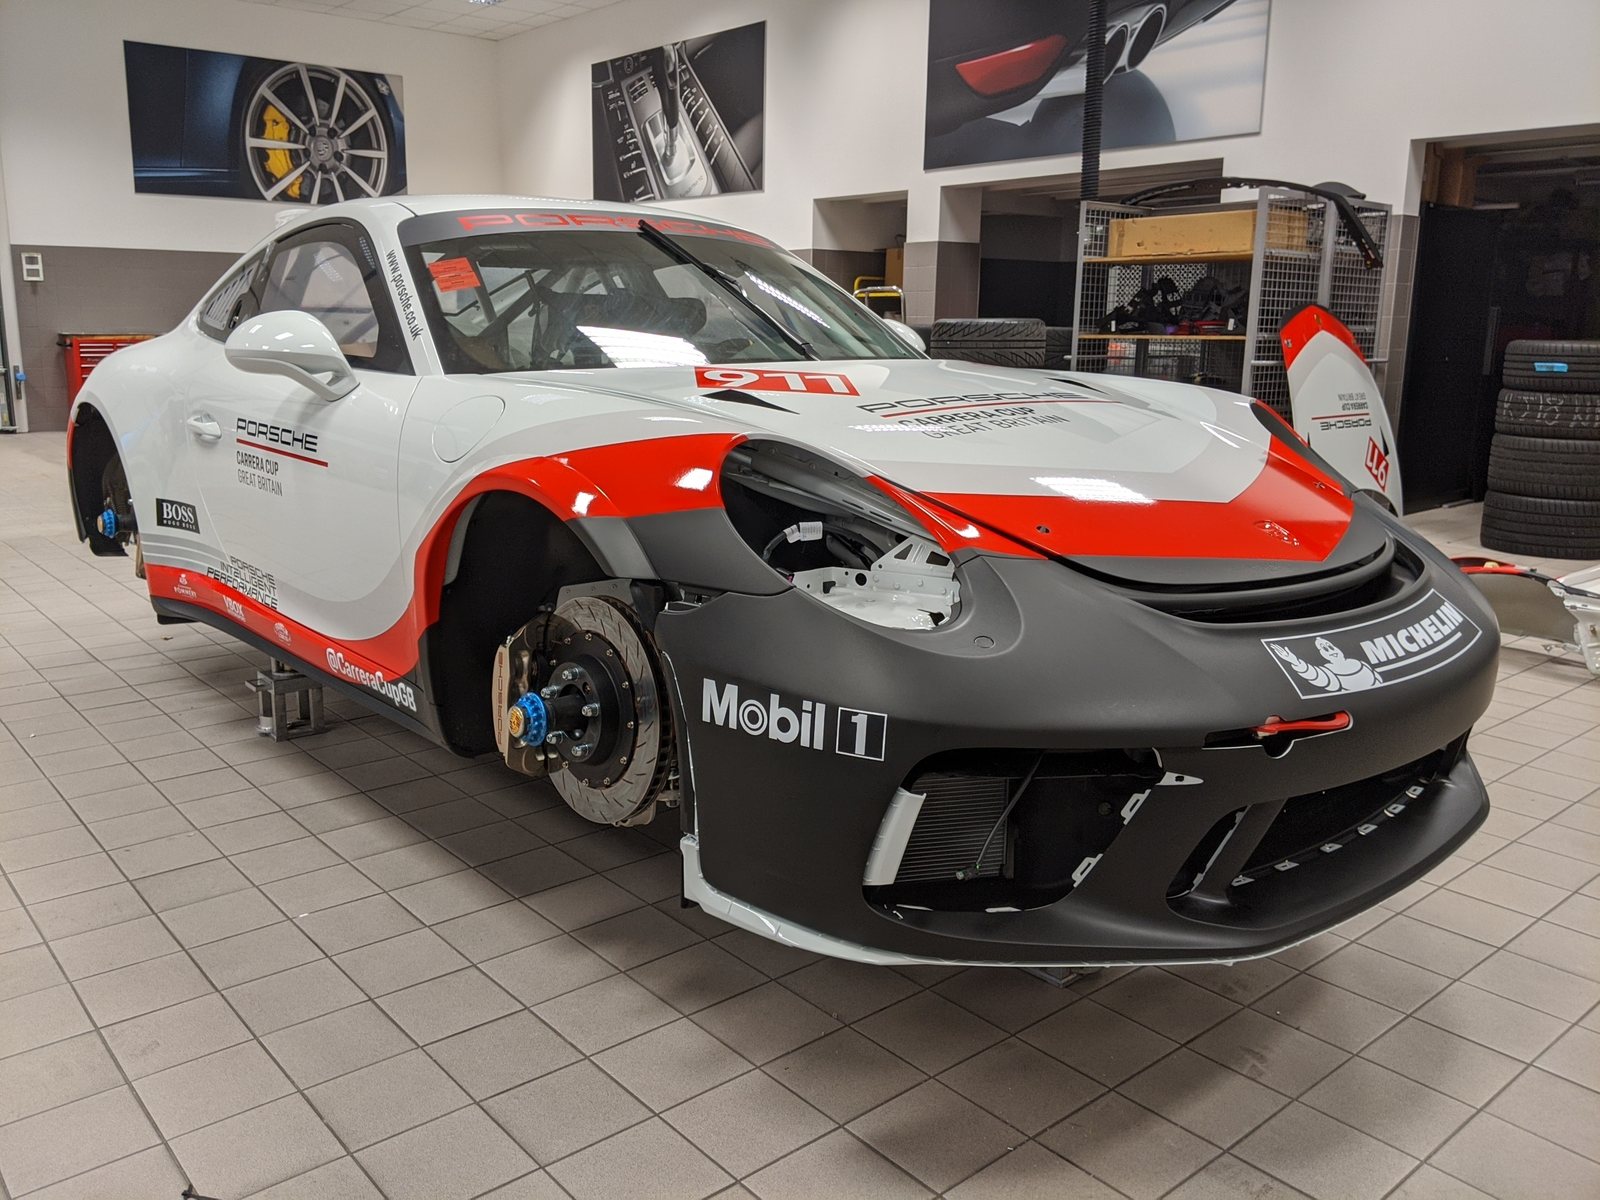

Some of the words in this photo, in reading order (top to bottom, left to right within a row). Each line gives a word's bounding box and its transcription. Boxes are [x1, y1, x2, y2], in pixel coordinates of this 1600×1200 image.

[457, 214, 775, 248] PORSCHE
[386, 249, 424, 341] www.porsche.co.uk
[703, 370, 850, 394] 911
[856, 392, 1089, 413] PORSCHE
[898, 409, 999, 428] CARRERA
[994, 406, 1036, 416] CUP
[236, 418, 318, 452] PORSCHE
[988, 414, 1071, 429] BRITAIN
[1320, 418, 1372, 431] PORSCHE
[236, 451, 264, 472] CARRERA
[265, 459, 279, 476] CUP
[1366, 440, 1388, 489] 911
[237, 469, 256, 487] GREAT
[257, 475, 283, 496] BRITAIN
[162, 502, 195, 524] BOSS
[220, 561, 277, 597] INTELLIGENT
[230, 555, 276, 586] PORSCHE
[206, 566, 279, 610] PERFORMANCE
[1360, 601, 1465, 665] MICHELIN
[326, 648, 418, 713] @CarreraCupGB
[702, 677, 826, 751] Mobil
